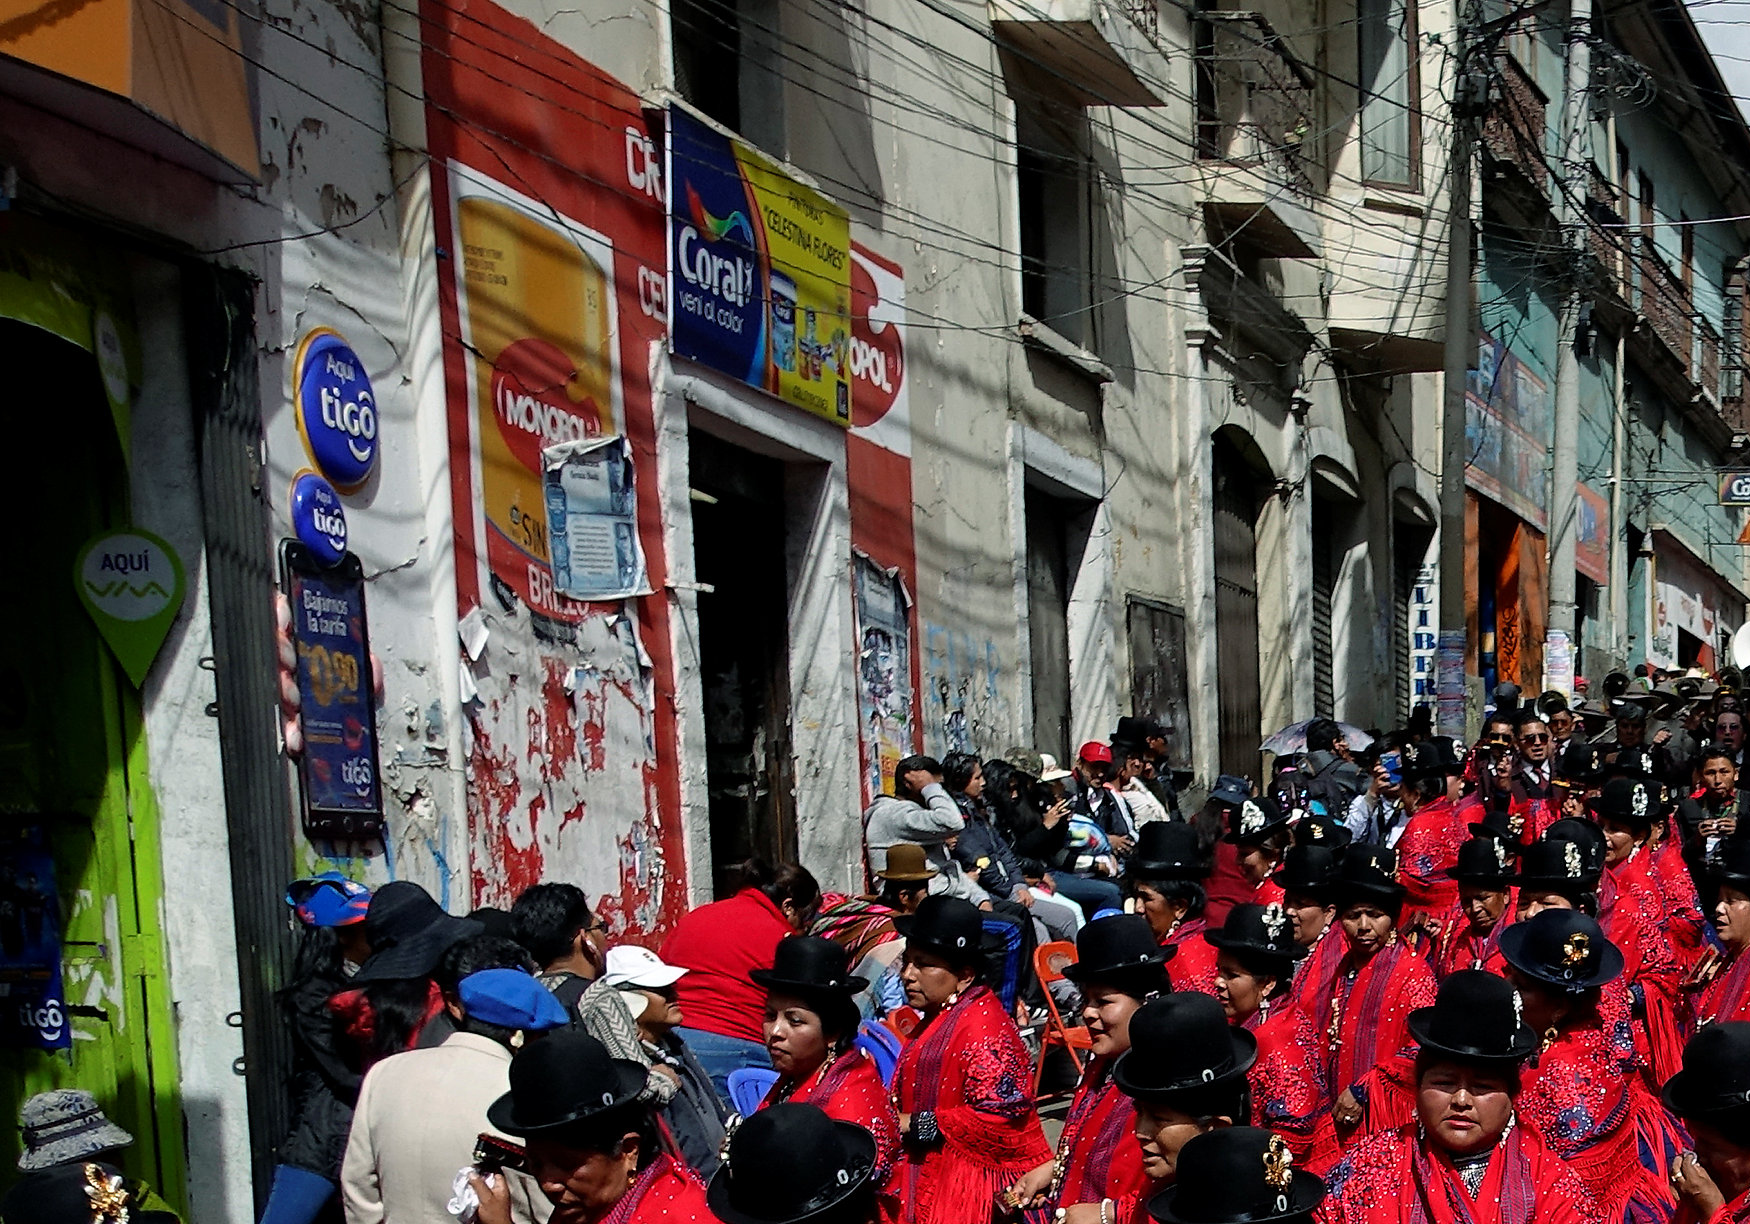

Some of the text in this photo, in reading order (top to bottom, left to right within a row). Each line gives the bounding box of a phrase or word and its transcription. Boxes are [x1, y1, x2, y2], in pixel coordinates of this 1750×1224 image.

[679, 225, 745, 308] Coral
[717, 308, 745, 336] color
[321, 386, 375, 440] tigo
[506, 394, 587, 442] MONOPOL
[313, 508, 345, 538] tigo
[101, 550, 150, 575] AQUÍ
